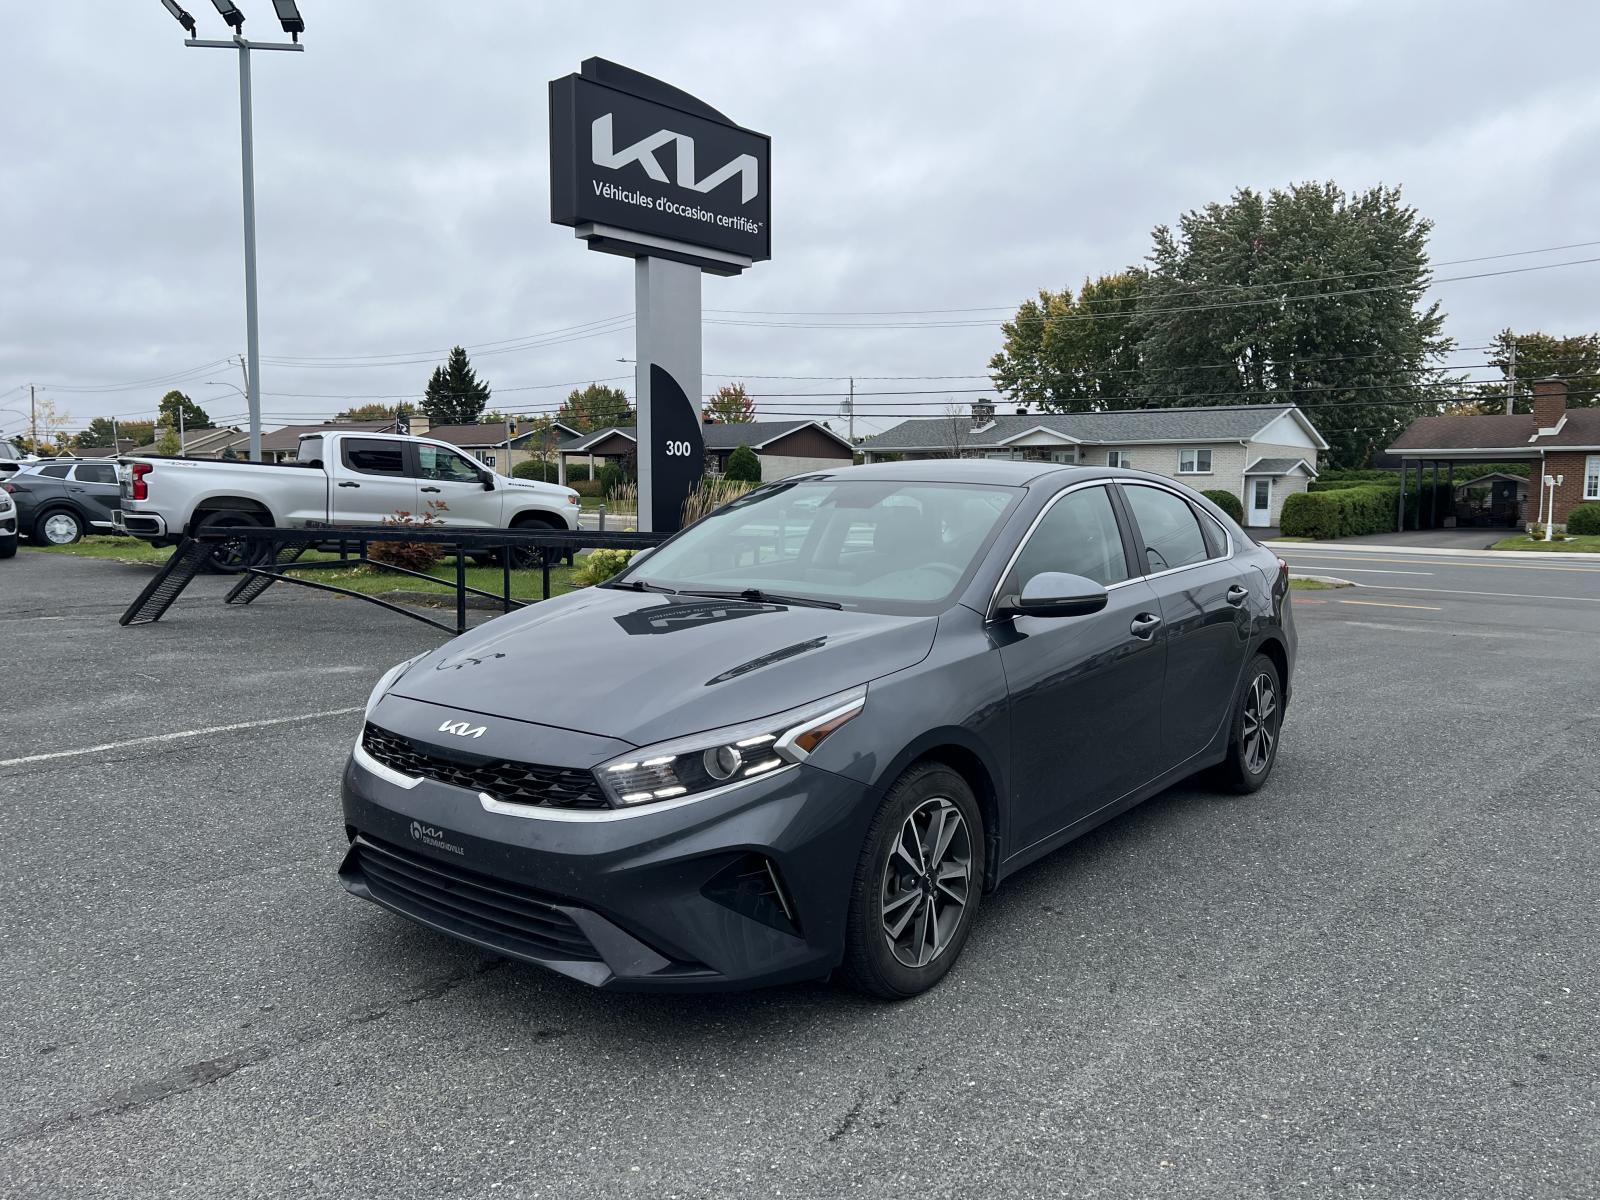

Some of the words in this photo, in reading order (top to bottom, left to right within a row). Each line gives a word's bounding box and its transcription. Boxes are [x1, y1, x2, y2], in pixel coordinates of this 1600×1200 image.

[592, 112, 758, 205] KIA
[592, 179, 653, 209] Véhicules
[656, 196, 714, 223] d'occasion
[716, 213, 758, 234] certifiés
[666, 440, 691, 457] 300
[438, 719, 487, 739] KIA
